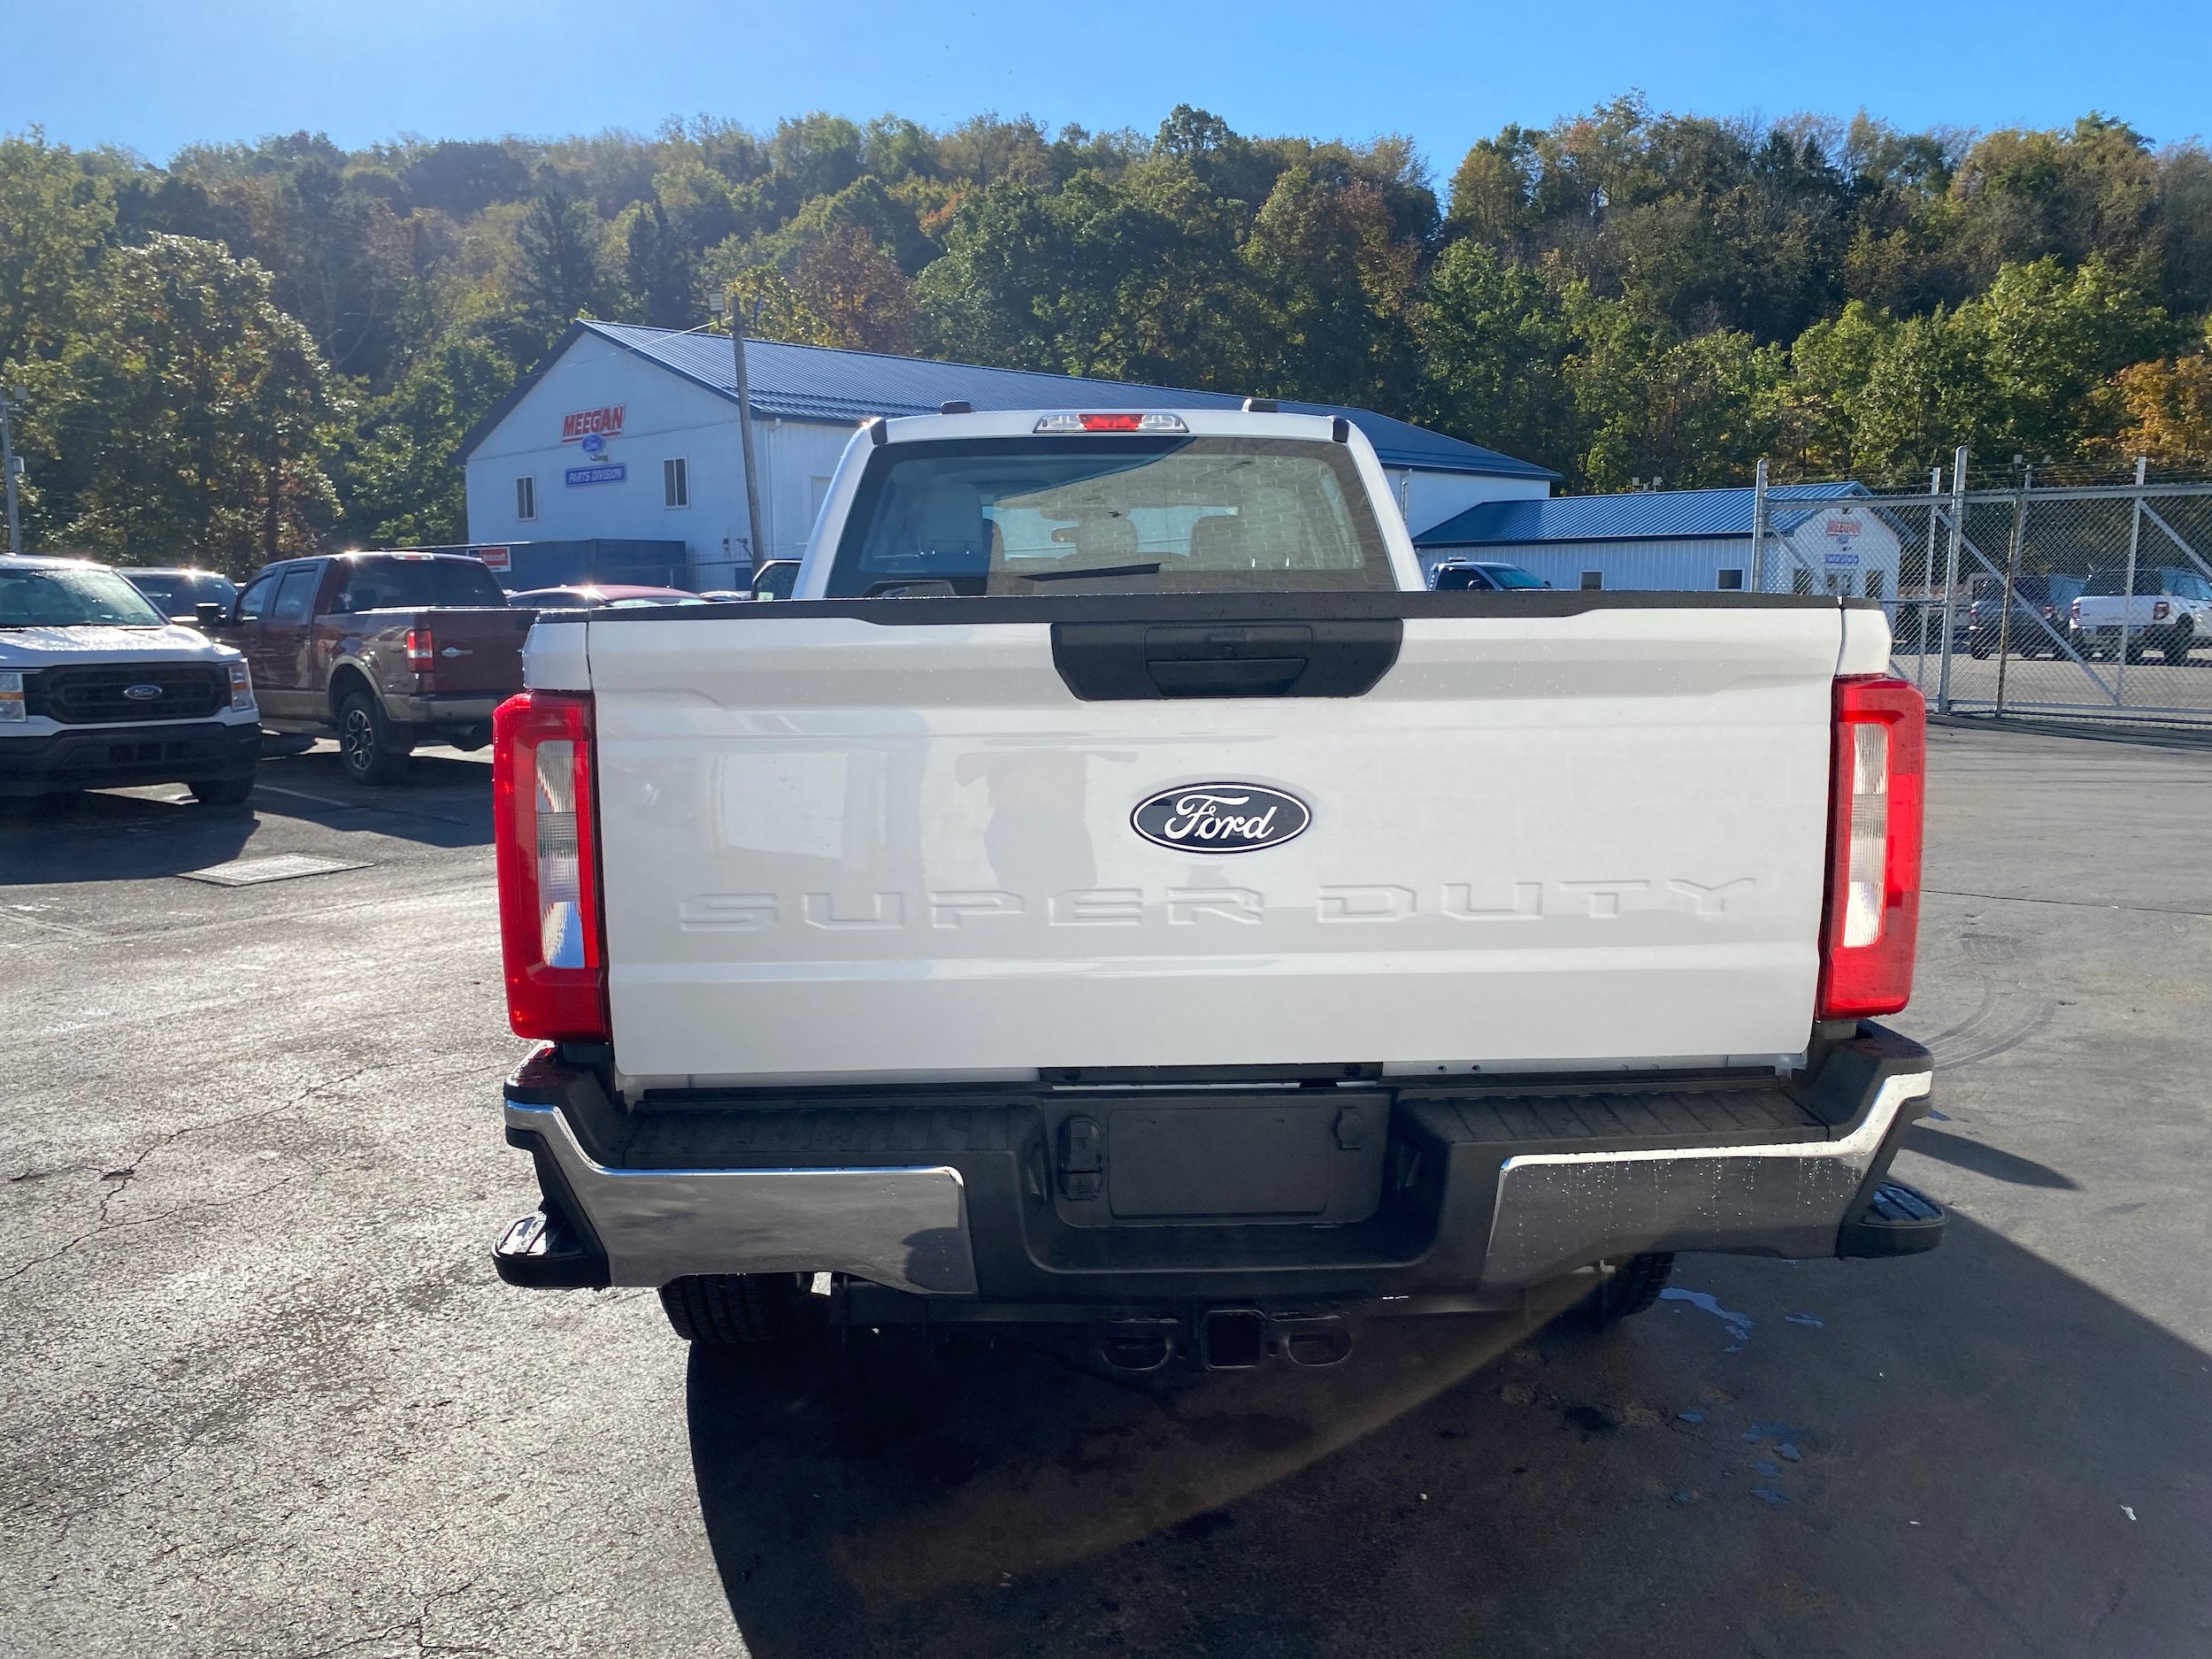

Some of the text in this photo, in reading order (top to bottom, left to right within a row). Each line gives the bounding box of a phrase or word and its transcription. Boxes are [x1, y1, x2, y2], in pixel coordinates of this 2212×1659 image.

[562, 405, 624, 438] MEEGAN
[568, 467, 623, 484] PARTS DIVISION
[1164, 794, 1279, 840] Ford
[680, 877, 1756, 932] SUPER DUTY
